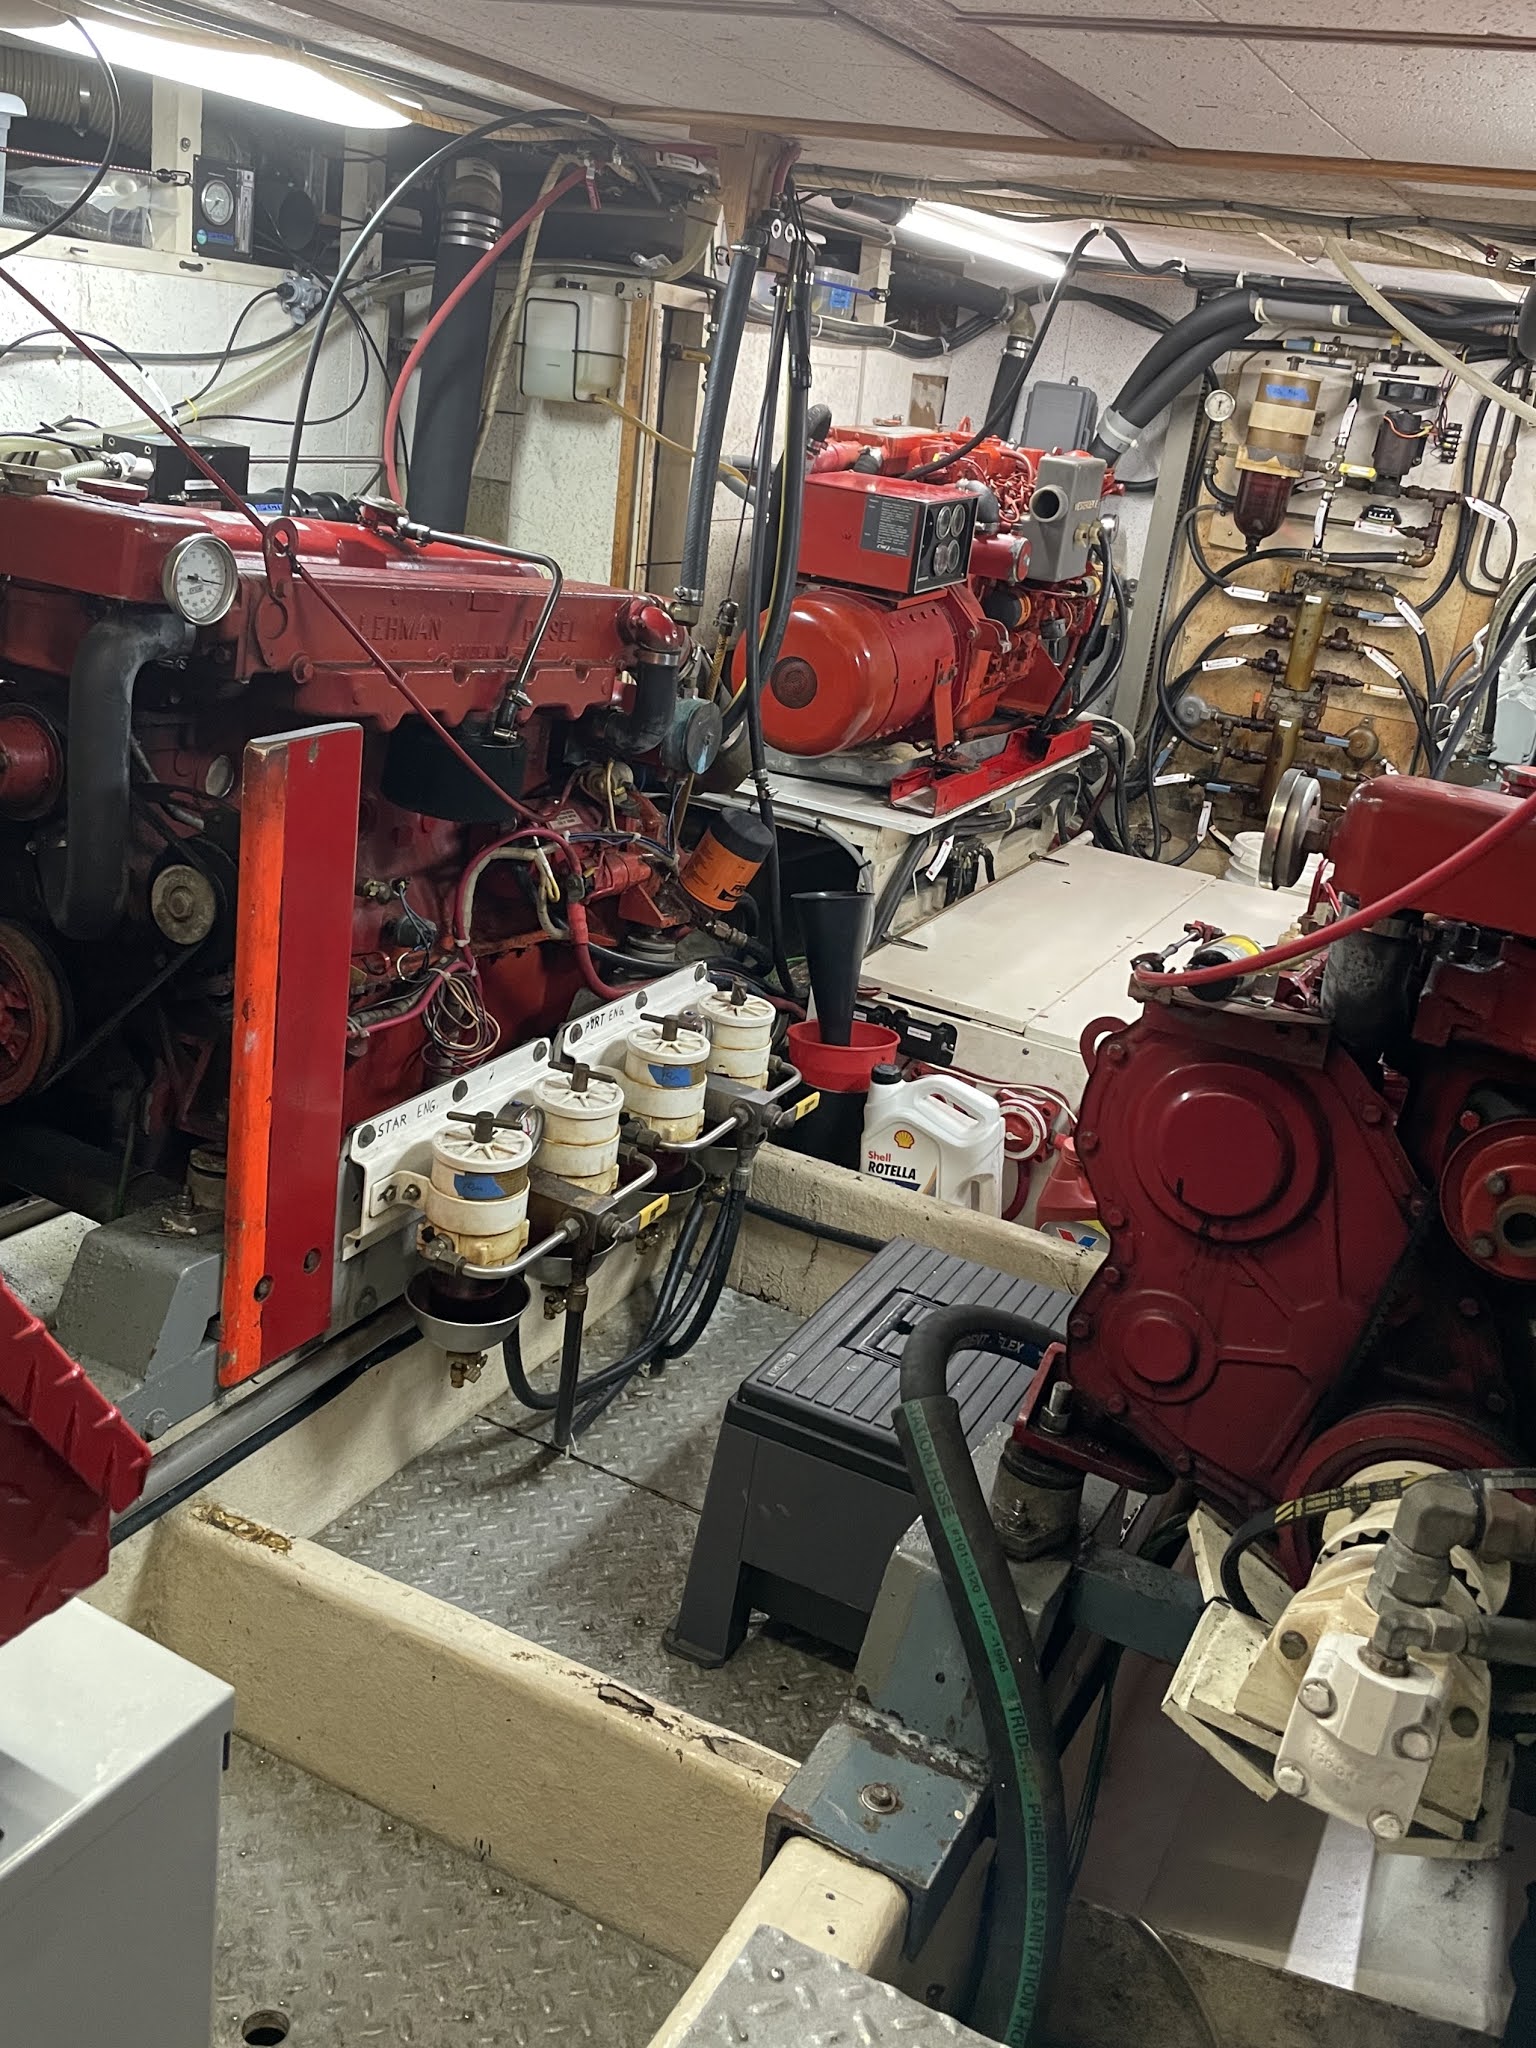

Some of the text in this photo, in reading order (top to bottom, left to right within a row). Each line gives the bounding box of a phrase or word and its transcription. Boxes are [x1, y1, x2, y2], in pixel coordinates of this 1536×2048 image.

[358, 614, 577, 643] LEHMAN DSEL
[585, 1013, 605, 1034] PORT
[377, 1114, 407, 1137] STAR
[868, 1151, 891, 1162] Shell
[868, 1161, 916, 1180] ROTELLA
[929, 1469, 956, 1519] HOSE
[1018, 1897, 1047, 2011] SANITATION
